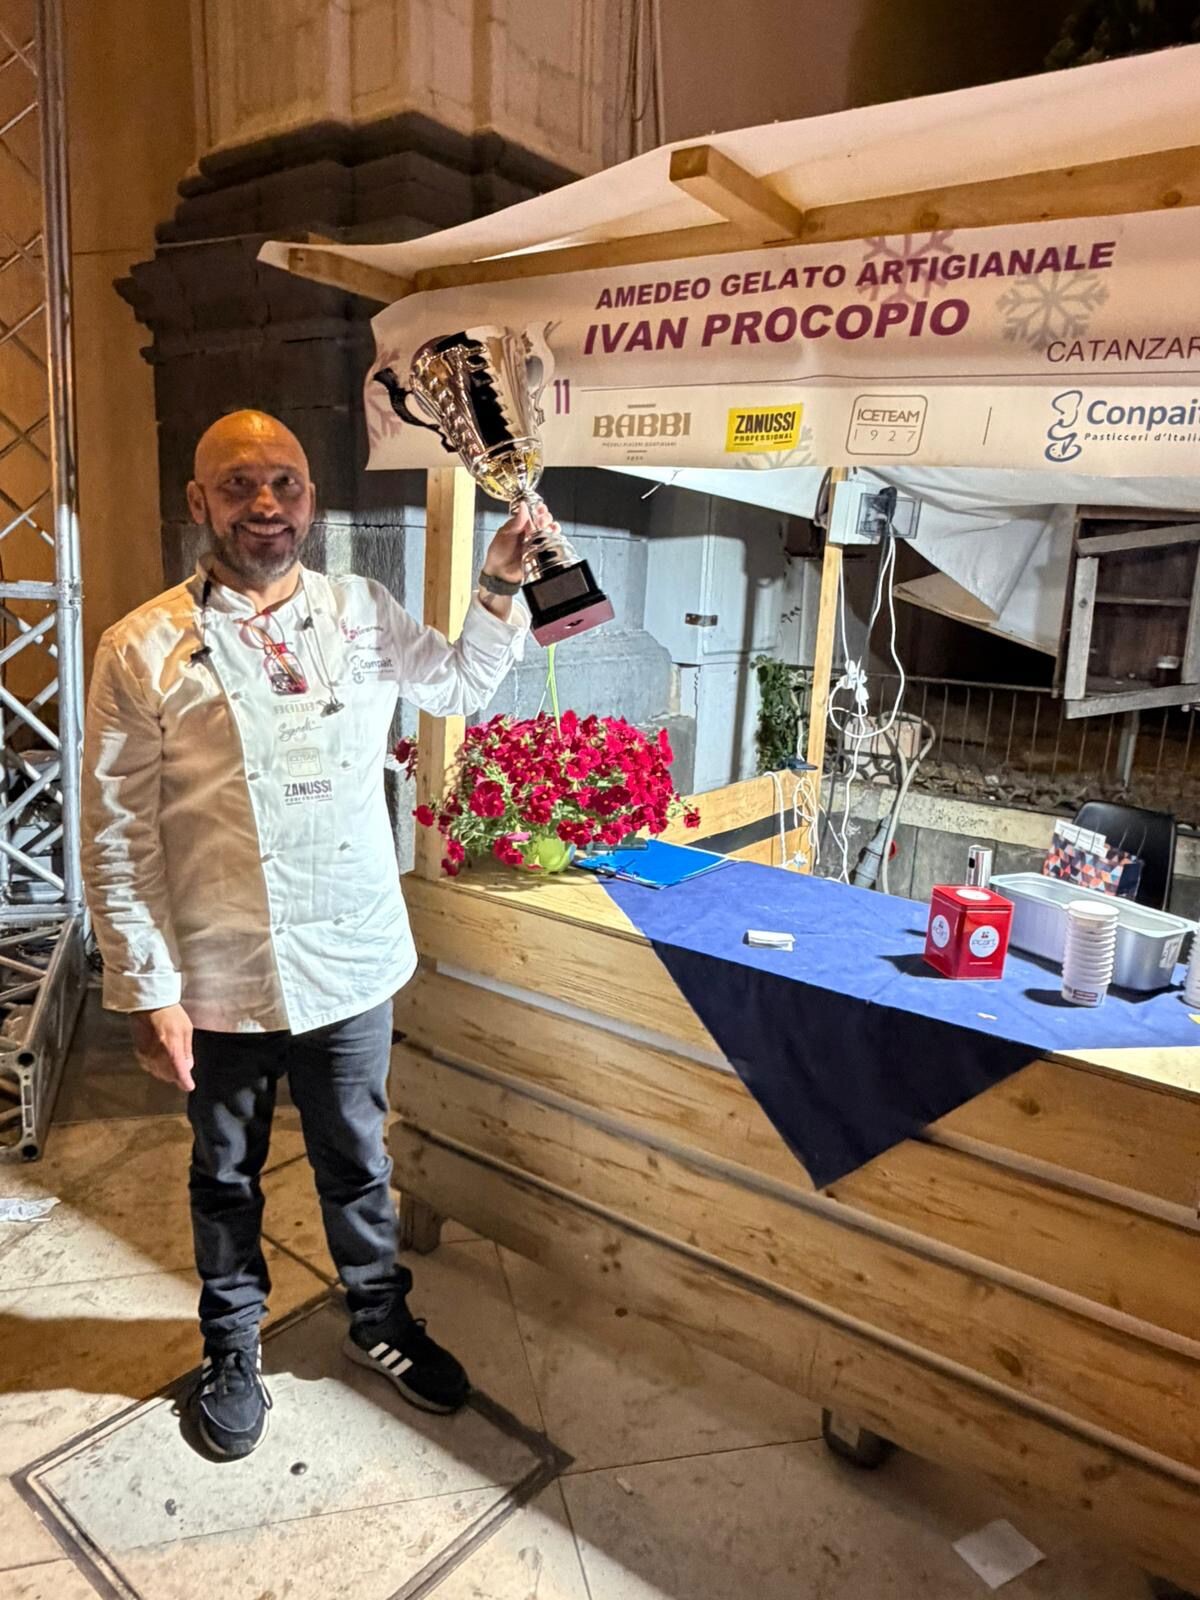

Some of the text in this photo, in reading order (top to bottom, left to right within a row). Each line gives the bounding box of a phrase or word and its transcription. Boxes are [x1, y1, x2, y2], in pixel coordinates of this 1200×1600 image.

[596, 241, 1116, 309] AMEDEO GELATO ARTIGIANALE
[583, 299, 970, 355] IVAN PROCOPIO
[553, 379, 570, 414] 11
[592, 412, 691, 438] BABBI
[735, 411, 797, 434] ZANUSSI
[856, 408, 920, 423] ICETEAM
[853, 429, 916, 442] 1927
[1084, 432, 1149, 442] Pasticceri
[283, 779, 332, 797] ZANUSSI
